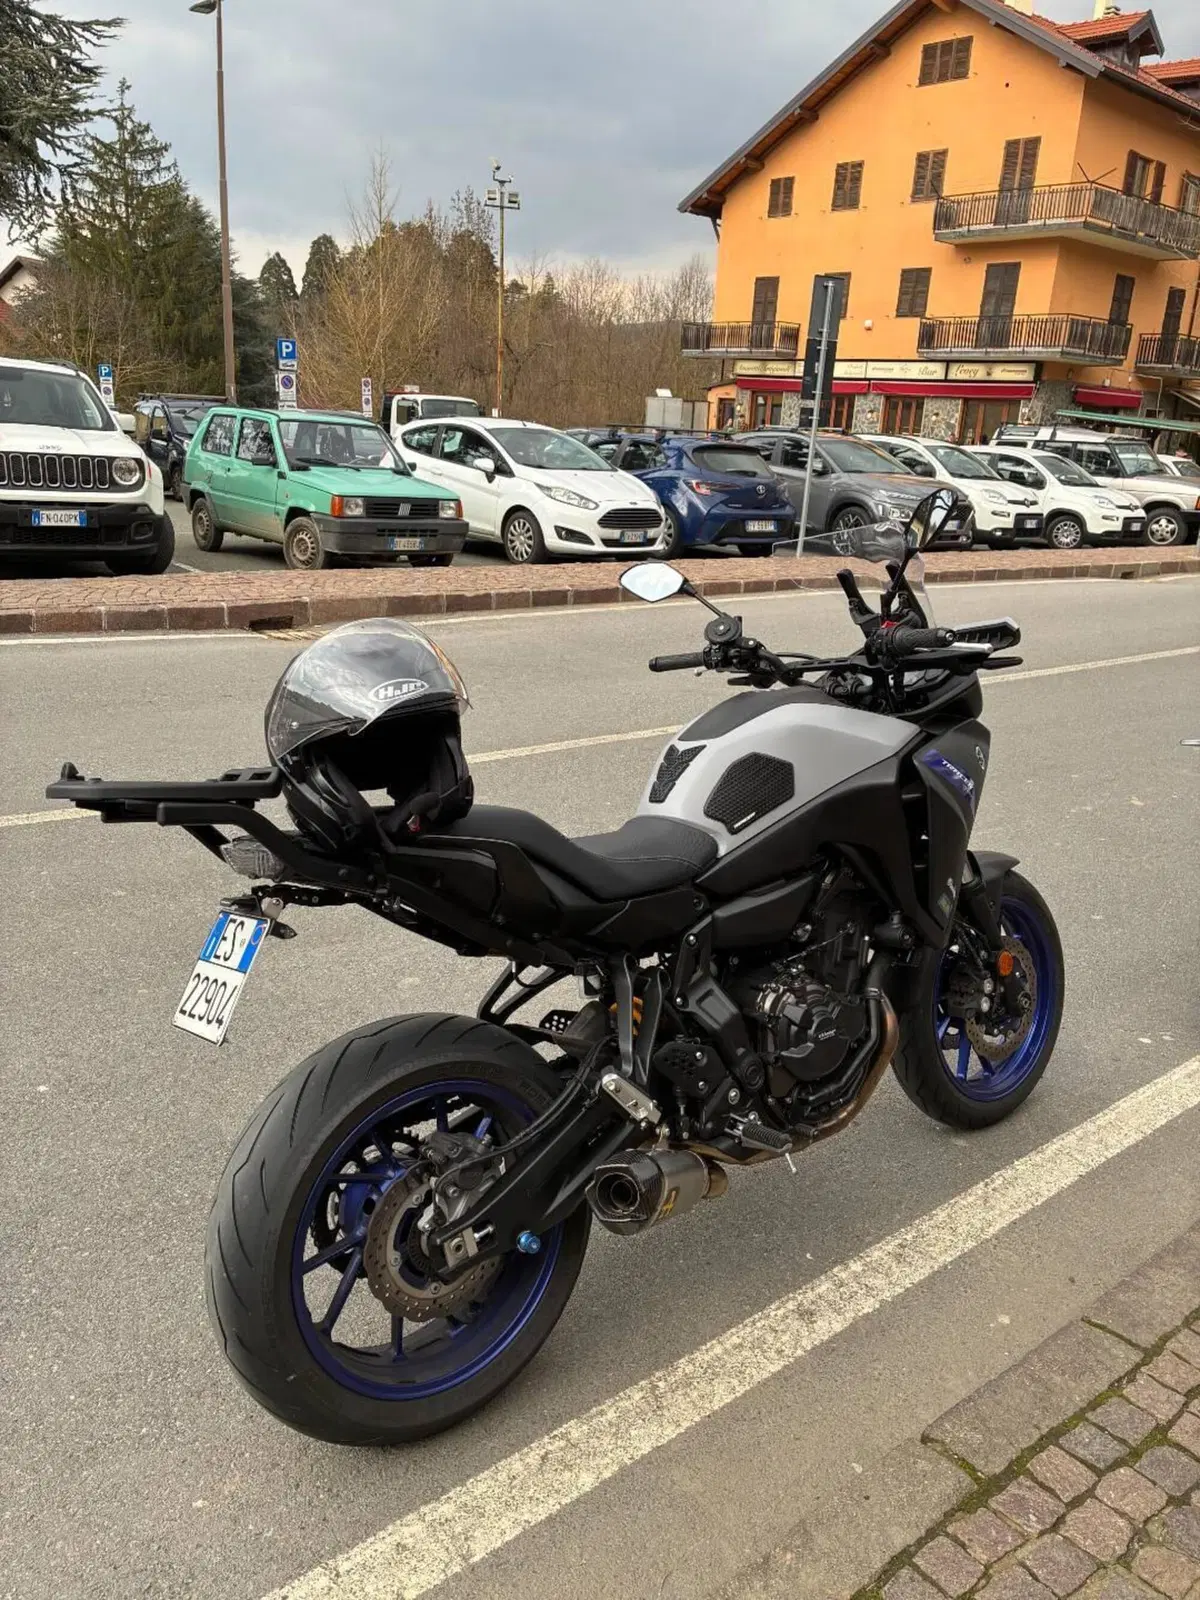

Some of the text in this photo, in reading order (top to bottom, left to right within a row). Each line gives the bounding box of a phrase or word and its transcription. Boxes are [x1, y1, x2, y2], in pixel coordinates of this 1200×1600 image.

[281, 341, 293, 357] P
[101, 366, 109, 377] P
[212, 917, 246, 962] ES
[178, 972, 239, 1030] 22904
